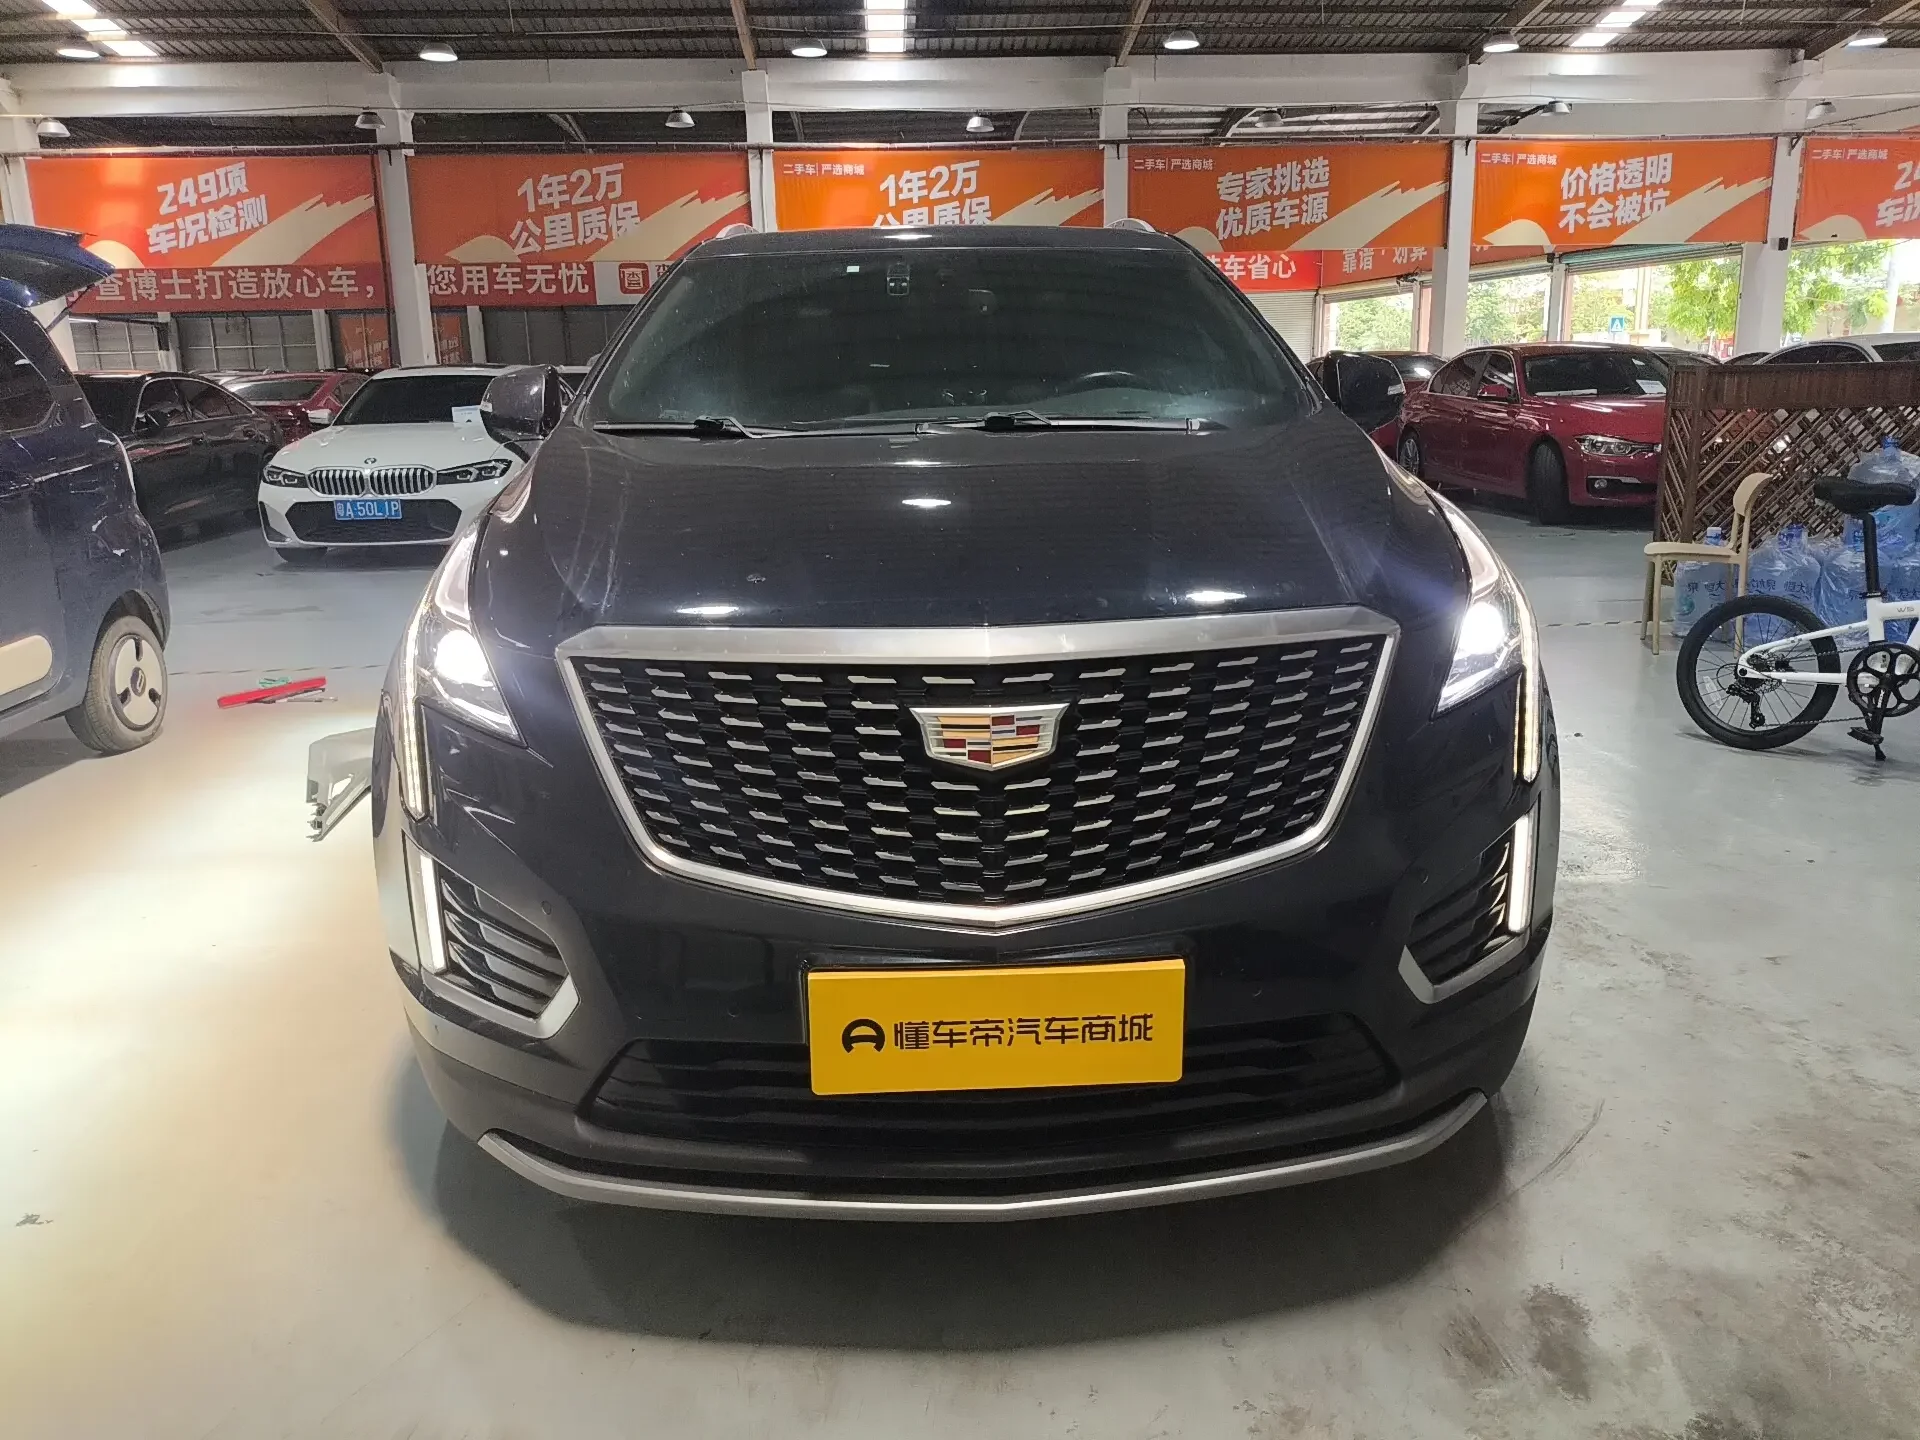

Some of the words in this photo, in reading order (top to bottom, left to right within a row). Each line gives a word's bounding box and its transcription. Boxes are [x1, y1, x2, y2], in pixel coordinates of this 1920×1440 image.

[518, 163, 624, 212] 1年2万
[879, 160, 980, 207] 1年2万
[1134, 158, 1166, 170] 二手车
[1216, 156, 1330, 204] 专家挑选
[1561, 153, 1673, 200] 价格透明
[157, 162, 249, 215] 249项
[1558, 187, 1671, 234] 不会被坑
[146, 194, 268, 254] 车况检测
[510, 200, 640, 256] 公里质保
[1215, 191, 1329, 241] 优质车源
[67, 266, 375, 302] 查博士打造放心车，
[427, 264, 590, 296] 您用车无忧
[893, 1013, 1154, 1051] 懂车帝汽车商城
